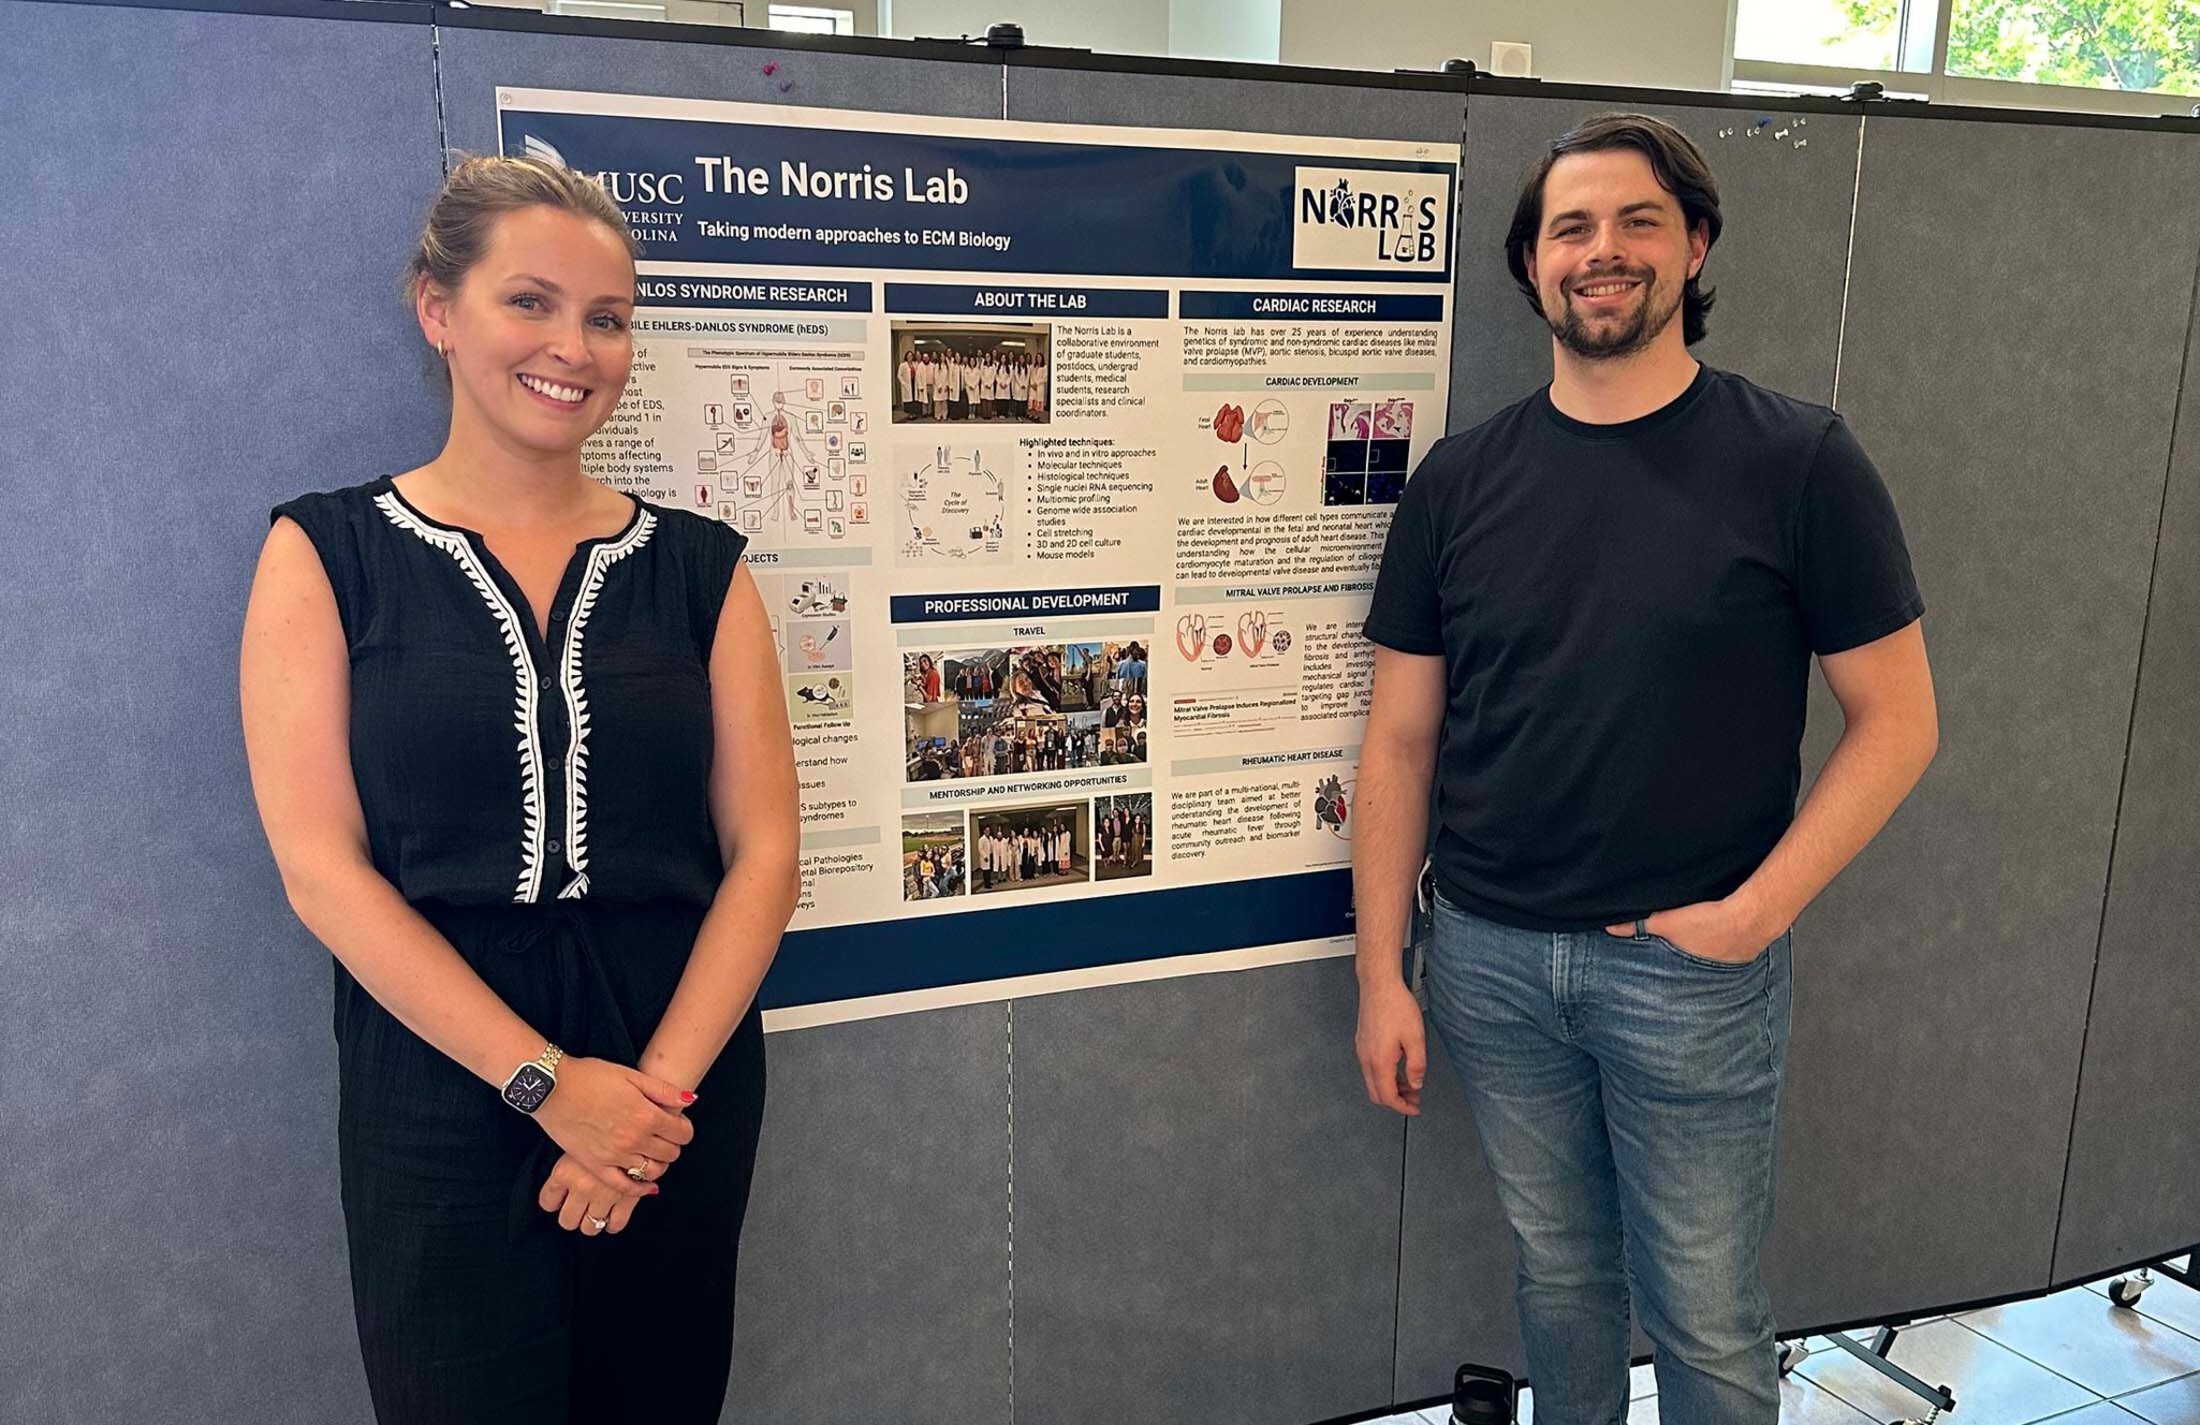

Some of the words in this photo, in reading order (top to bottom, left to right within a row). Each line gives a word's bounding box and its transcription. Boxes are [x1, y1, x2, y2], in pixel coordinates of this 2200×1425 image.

[695, 156, 769, 194] The
[781, 161, 893, 200] Norris
[905, 168, 967, 204] Lab
[621, 211, 684, 225] VERSITY
[630, 229, 678, 241] OLINA
[698, 220, 749, 241] Taking
[752, 223, 811, 240] modern
[815, 227, 900, 244] approaches
[904, 230, 919, 244] to
[922, 230, 955, 245] ECM
[958, 231, 1010, 251] Biology
[636, 282, 677, 298] NLOS
[680, 283, 766, 299] SYNDROME
[769, 286, 847, 301] RESEARCH
[974, 292, 1024, 306] ABOUT
[1027, 293, 1056, 307] THE
[1058, 294, 1086, 308] LAB
[1252, 298, 1309, 312] CARDIAC
[1311, 299, 1376, 312] RESEARCH
[651, 320, 736, 332] EHLERS-DANLOS
[738, 322, 794, 333] SYNDROME
[796, 324, 828, 336] (hEDS)
[1057, 325, 1072, 334] The
[1074, 326, 1099, 335] Norris
[1100, 326, 1116, 335] Lab
[1117, 326, 1125, 335] is
[1056, 338, 1108, 347] collaborative
[1110, 339, 1159, 347] environment
[1056, 349, 1065, 358] of
[1066, 350, 1103, 360] graduate
[1104, 350, 1141, 360] students,
[1056, 361, 1096, 371] postdocs,
[1097, 362, 1138, 372] undergrad
[1056, 373, 1094, 384] students,
[1094, 373, 1127, 382] medical
[1265, 377, 1301, 385] CARDIAC
[1302, 377, 1358, 385] DEVELOPMENT
[1056, 385, 1093, 394] students,
[1094, 385, 1129, 394] research
[630, 399, 640, 409] of
[642, 399, 664, 410] EDS,
[1056, 397, 1099, 406] specialists
[1100, 396, 1116, 405] and
[1117, 396, 1145, 405] clinical
[608, 411, 642, 422] around
[614, 439, 642, 449] range
[1018, 438, 1067, 448] Highlighted
[1068, 437, 1115, 447] techniques:
[618, 450, 661, 462] affecting
[1038, 450, 1046, 458] In
[1110, 448, 1156, 458] approaches
[606, 463, 631, 474] body
[632, 464, 673, 474] systems
[1037, 460, 1077, 469] Molecular
[1078, 460, 1122, 470] techniques
[614, 476, 632, 485] into
[634, 475, 650, 484] the
[1037, 471, 1084, 482] Histological
[1086, 471, 1129, 481] techniques
[632, 487, 666, 499] biology
[1036, 483, 1062, 494] Single
[1064, 483, 1088, 492] nuclei
[1108, 482, 1153, 492] sequencing
[1036, 493, 1077, 503] Multiomic
[1078, 493, 1110, 504] profiling
[1036, 506, 1070, 514] Genome
[1092, 505, 1137, 513] association
[1036, 517, 1066, 526] studies
[1036, 528, 1052, 537] Cell
[1053, 528, 1093, 537] stretching
[1036, 540, 1048, 548] 3D
[1049, 539, 1065, 548] and
[1066, 539, 1077, 547] 2D
[1078, 539, 1093, 547] cell
[1094, 538, 1121, 546] culture
[742, 554, 778, 563] OJECTS
[1064, 549, 1094, 558] models
[1256, 587, 1280, 595] VALVE
[1282, 585, 1322, 594] PROLAPSE
[1322, 584, 1339, 592] AND
[1340, 582, 1375, 591] FIBROSIS
[924, 596, 1029, 613] PROFESSIONAL
[1032, 592, 1129, 608] DEVELOPMENT
[1013, 626, 1045, 635] TRAVEL
[822, 734, 858, 743] changes
[829, 756, 848, 764] how
[1242, 754, 1285, 765] RHEUMATIC
[1286, 752, 1311, 761] HEART
[1312, 749, 1342, 759] DISEASE
[929, 787, 985, 799] MENTORSHIP
[986, 785, 1005, 794] AND
[1006, 780, 1062, 792] NETWORKING
[1063, 775, 1127, 788] OPPORTUNITIES
[808, 801, 846, 810] subtypes
[813, 853, 863, 865] Pathologies
[818, 863, 873, 875] Biorepository
